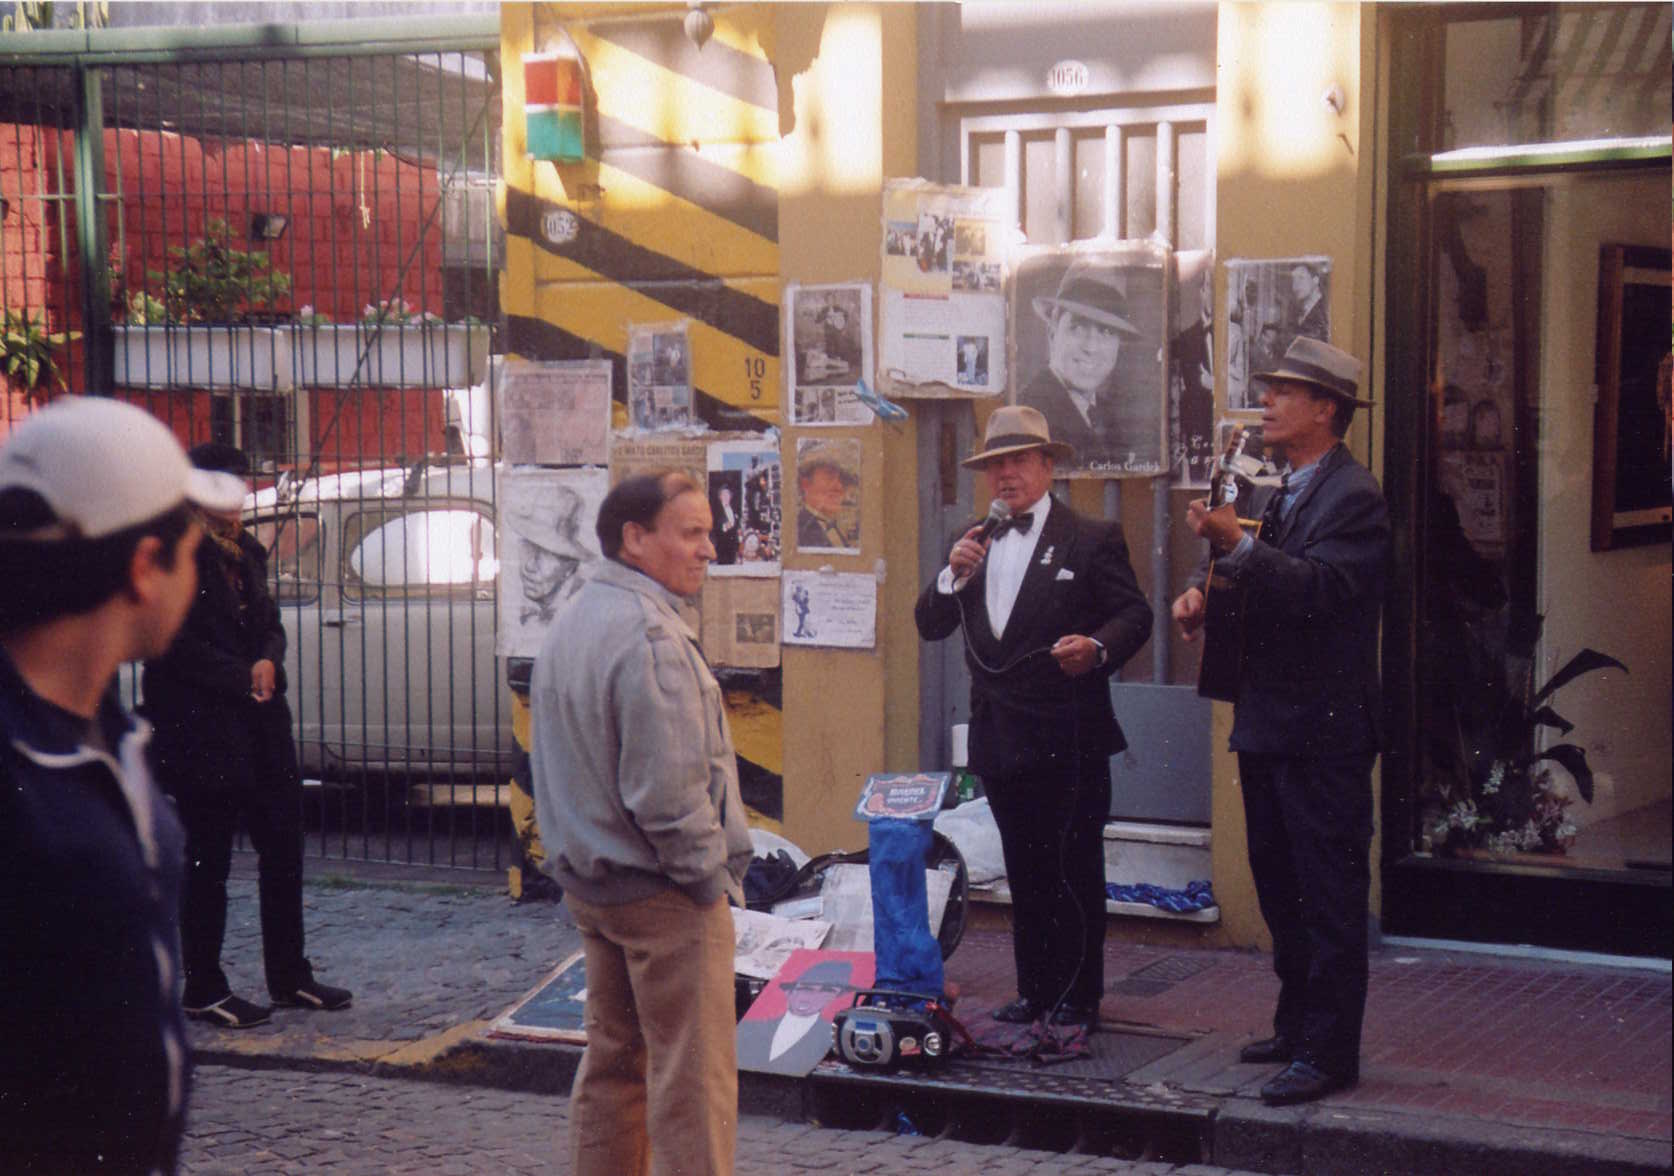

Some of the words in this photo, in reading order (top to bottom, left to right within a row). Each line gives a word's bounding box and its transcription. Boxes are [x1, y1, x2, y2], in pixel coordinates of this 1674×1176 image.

[1051, 65, 1084, 88] 1056
[745, 357, 766, 379] 10
[750, 379, 761, 400] 5
[1090, 460, 1121, 471] Carlos
[1124, 460, 1160, 472] Gardel
